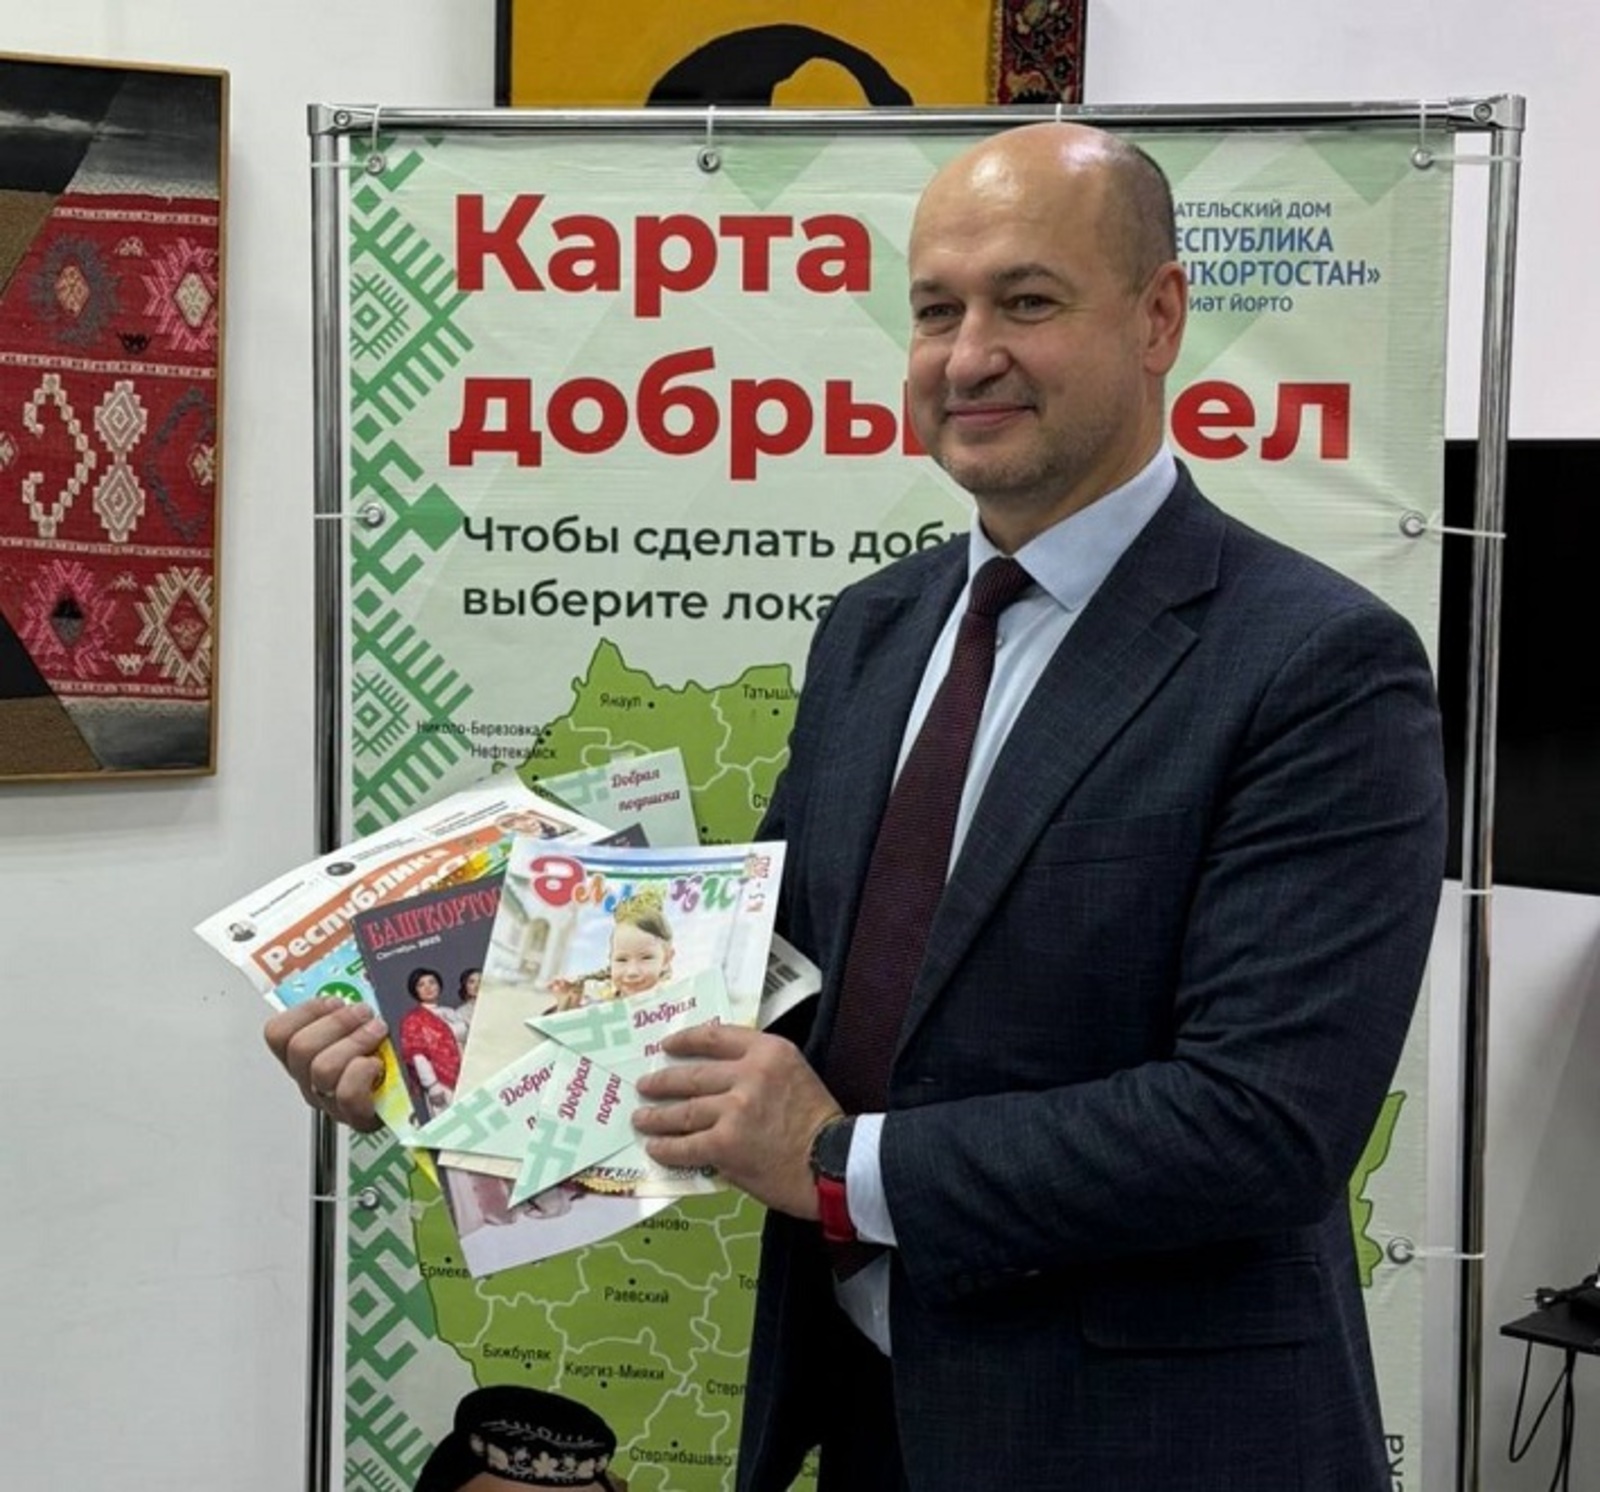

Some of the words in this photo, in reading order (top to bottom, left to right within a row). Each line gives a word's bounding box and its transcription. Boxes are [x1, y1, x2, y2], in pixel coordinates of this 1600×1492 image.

[1174, 199, 1282, 218] АТЕЛЬСКИЙ
[1286, 202, 1332, 219] ДОМ
[1175, 227, 1335, 253] ЕСПУБЛИКА
[455, 194, 871, 318] Карта
[1188, 296, 1225, 312] ИӘТ
[1230, 293, 1294, 313] ЙОРТО
[448, 346, 930, 481] добры
[1170, 380, 1350, 461] ел
[462, 516, 618, 554] Чтобы
[633, 523, 836, 559] сделать
[848, 520, 956, 565] доб
[462, 580, 708, 625] выберите
[722, 593, 838, 622] лока
[416, 719, 541, 738] Николо-Березовка
[471, 742, 556, 760] Нефтекамск
[611, 768, 661, 789] Добрая
[618, 789, 681, 812] подписка
[633, 997, 698, 1029] Добрая
[557, 1055, 593, 1121] Добрая
[596, 1072, 622, 1126] подпи
[603, 1286, 670, 1304] Раевский
[481, 1343, 552, 1361] Бижбуляк
[564, 1362, 665, 1380] Киргиз-Мияки
[629, 1447, 732, 1467] Стерлибашево
